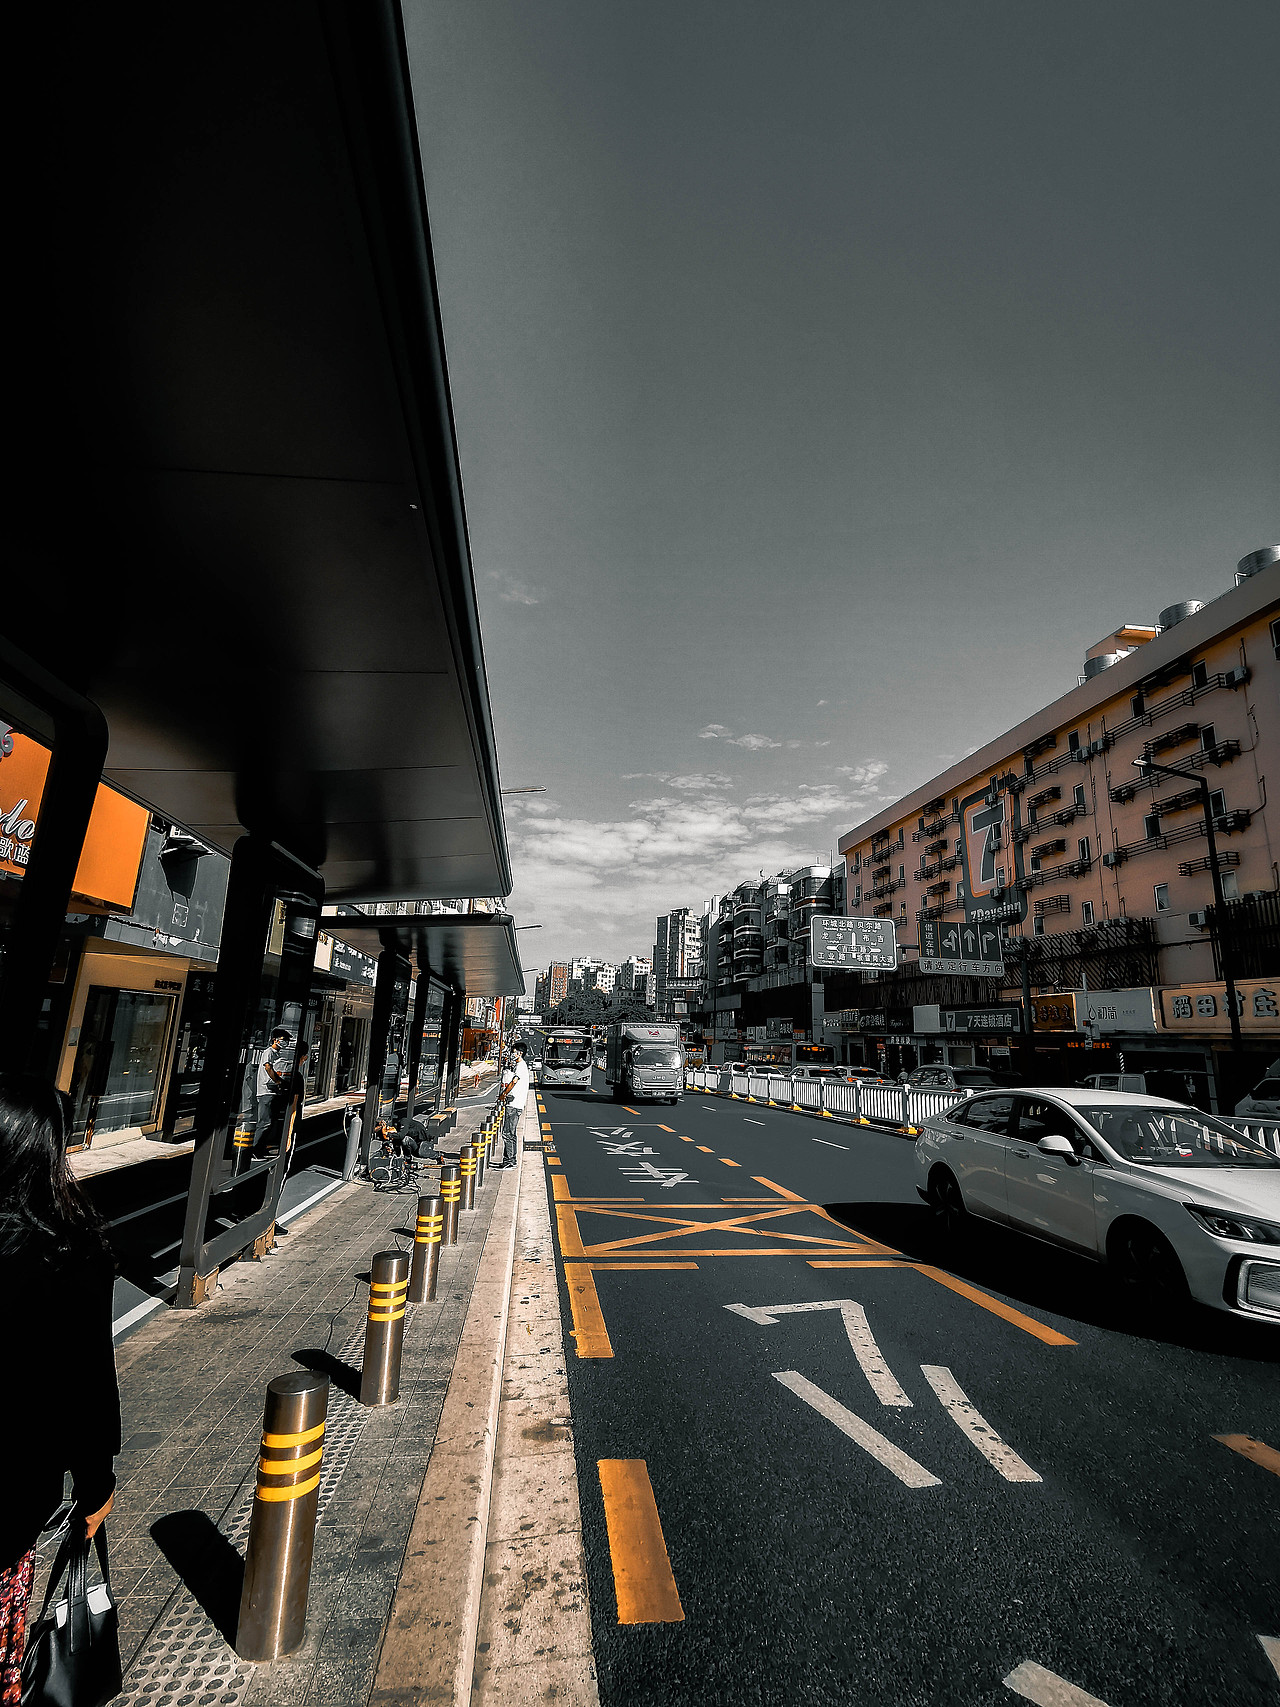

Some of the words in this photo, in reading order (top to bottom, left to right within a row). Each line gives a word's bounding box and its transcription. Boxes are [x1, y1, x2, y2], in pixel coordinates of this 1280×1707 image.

[857, 921, 882, 930] 贝尔路
[862, 934, 885, 943] 布吉
[817, 952, 846, 961] 工业路
[923, 960, 1003, 974] 请选定行车方向
[967, 1013, 1013, 1029] 7天连锁酒店
